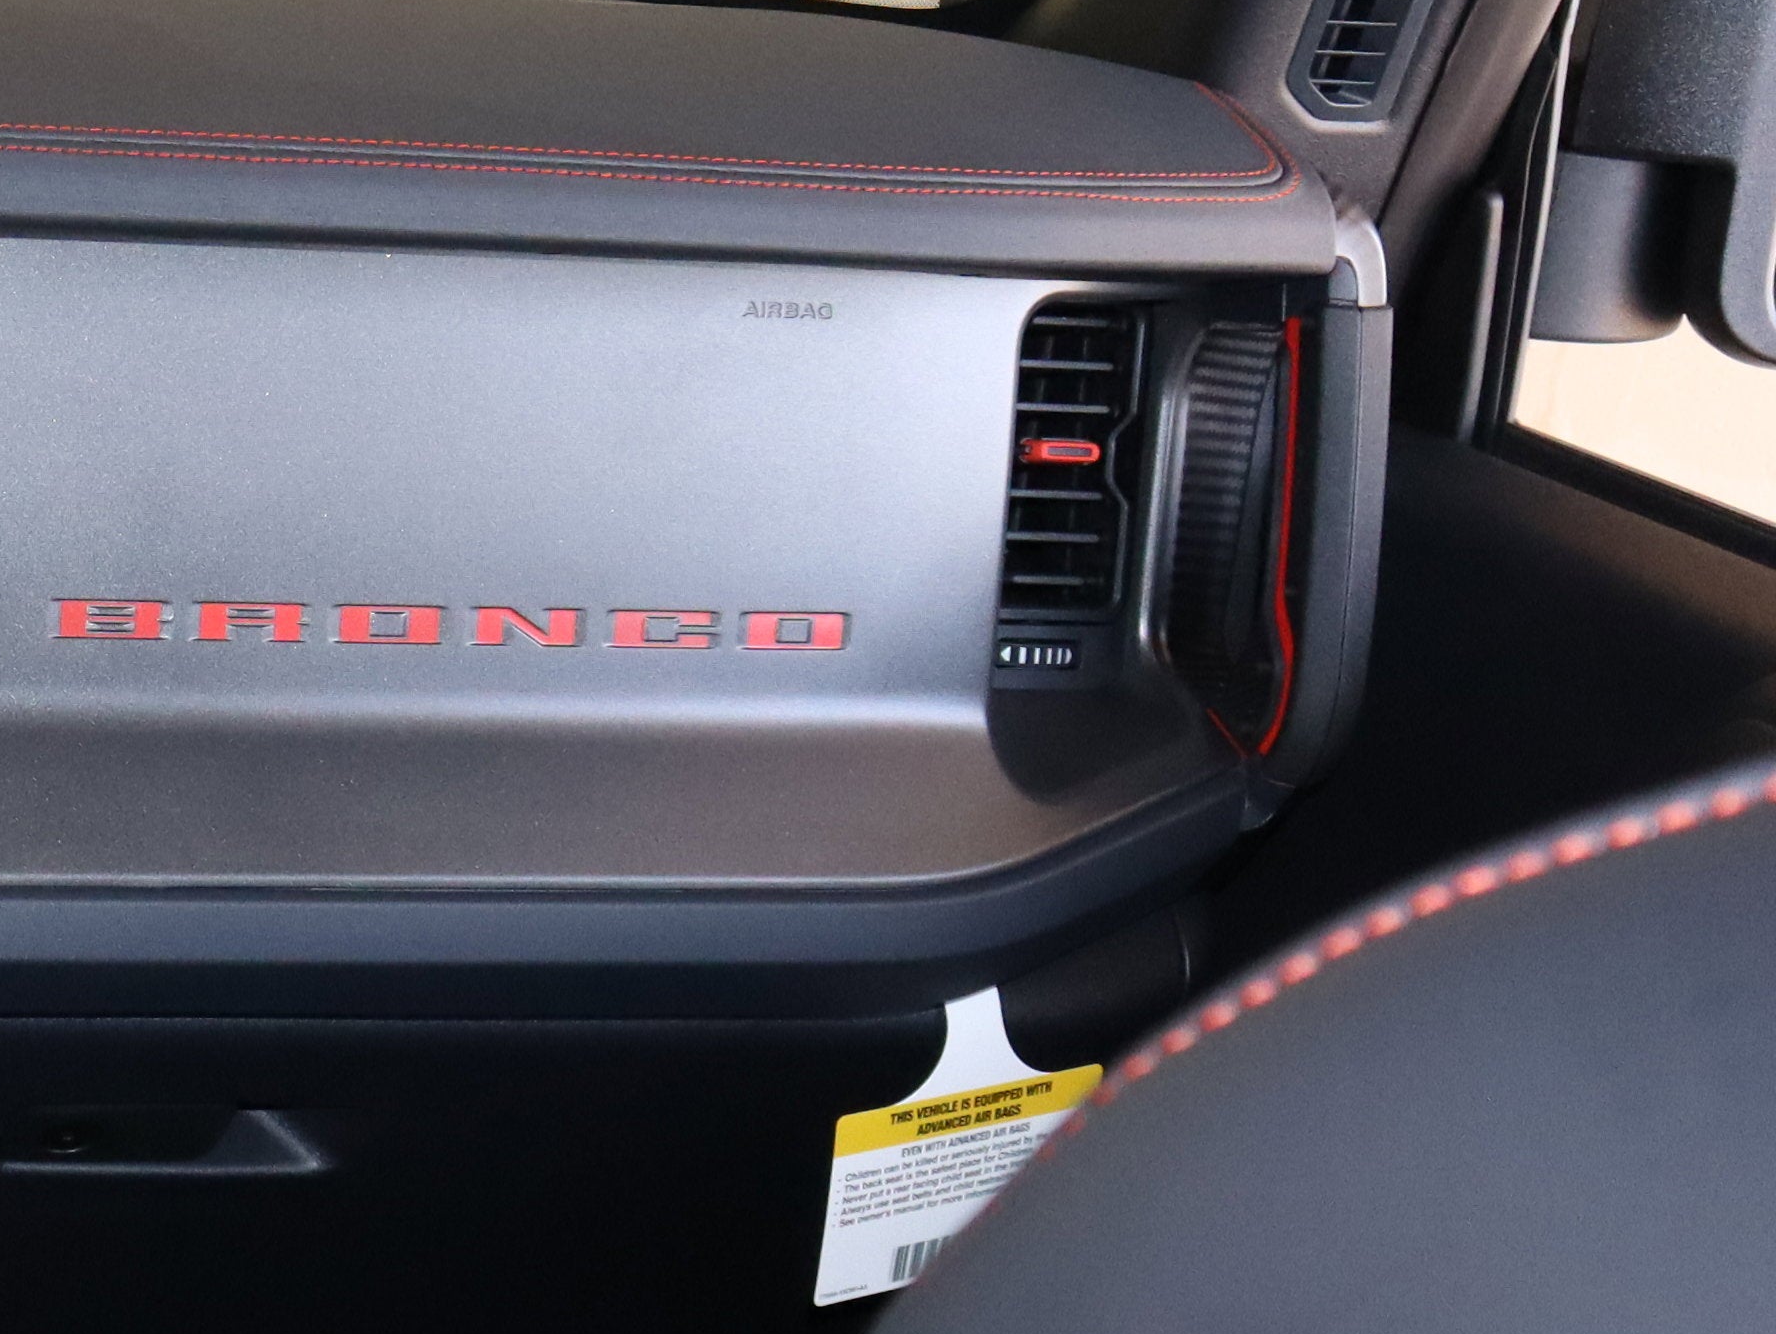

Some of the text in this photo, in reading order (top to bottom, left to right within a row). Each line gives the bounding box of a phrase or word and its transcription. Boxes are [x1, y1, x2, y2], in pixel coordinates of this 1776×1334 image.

[742, 300, 834, 320] AIRBAG
[50, 597, 850, 651] BRONCO
[891, 1080, 1051, 1125] THIS VEHICLE IS EQUIPPED WITH
[917, 1104, 1020, 1136] ADVANCED AIR BAGS
